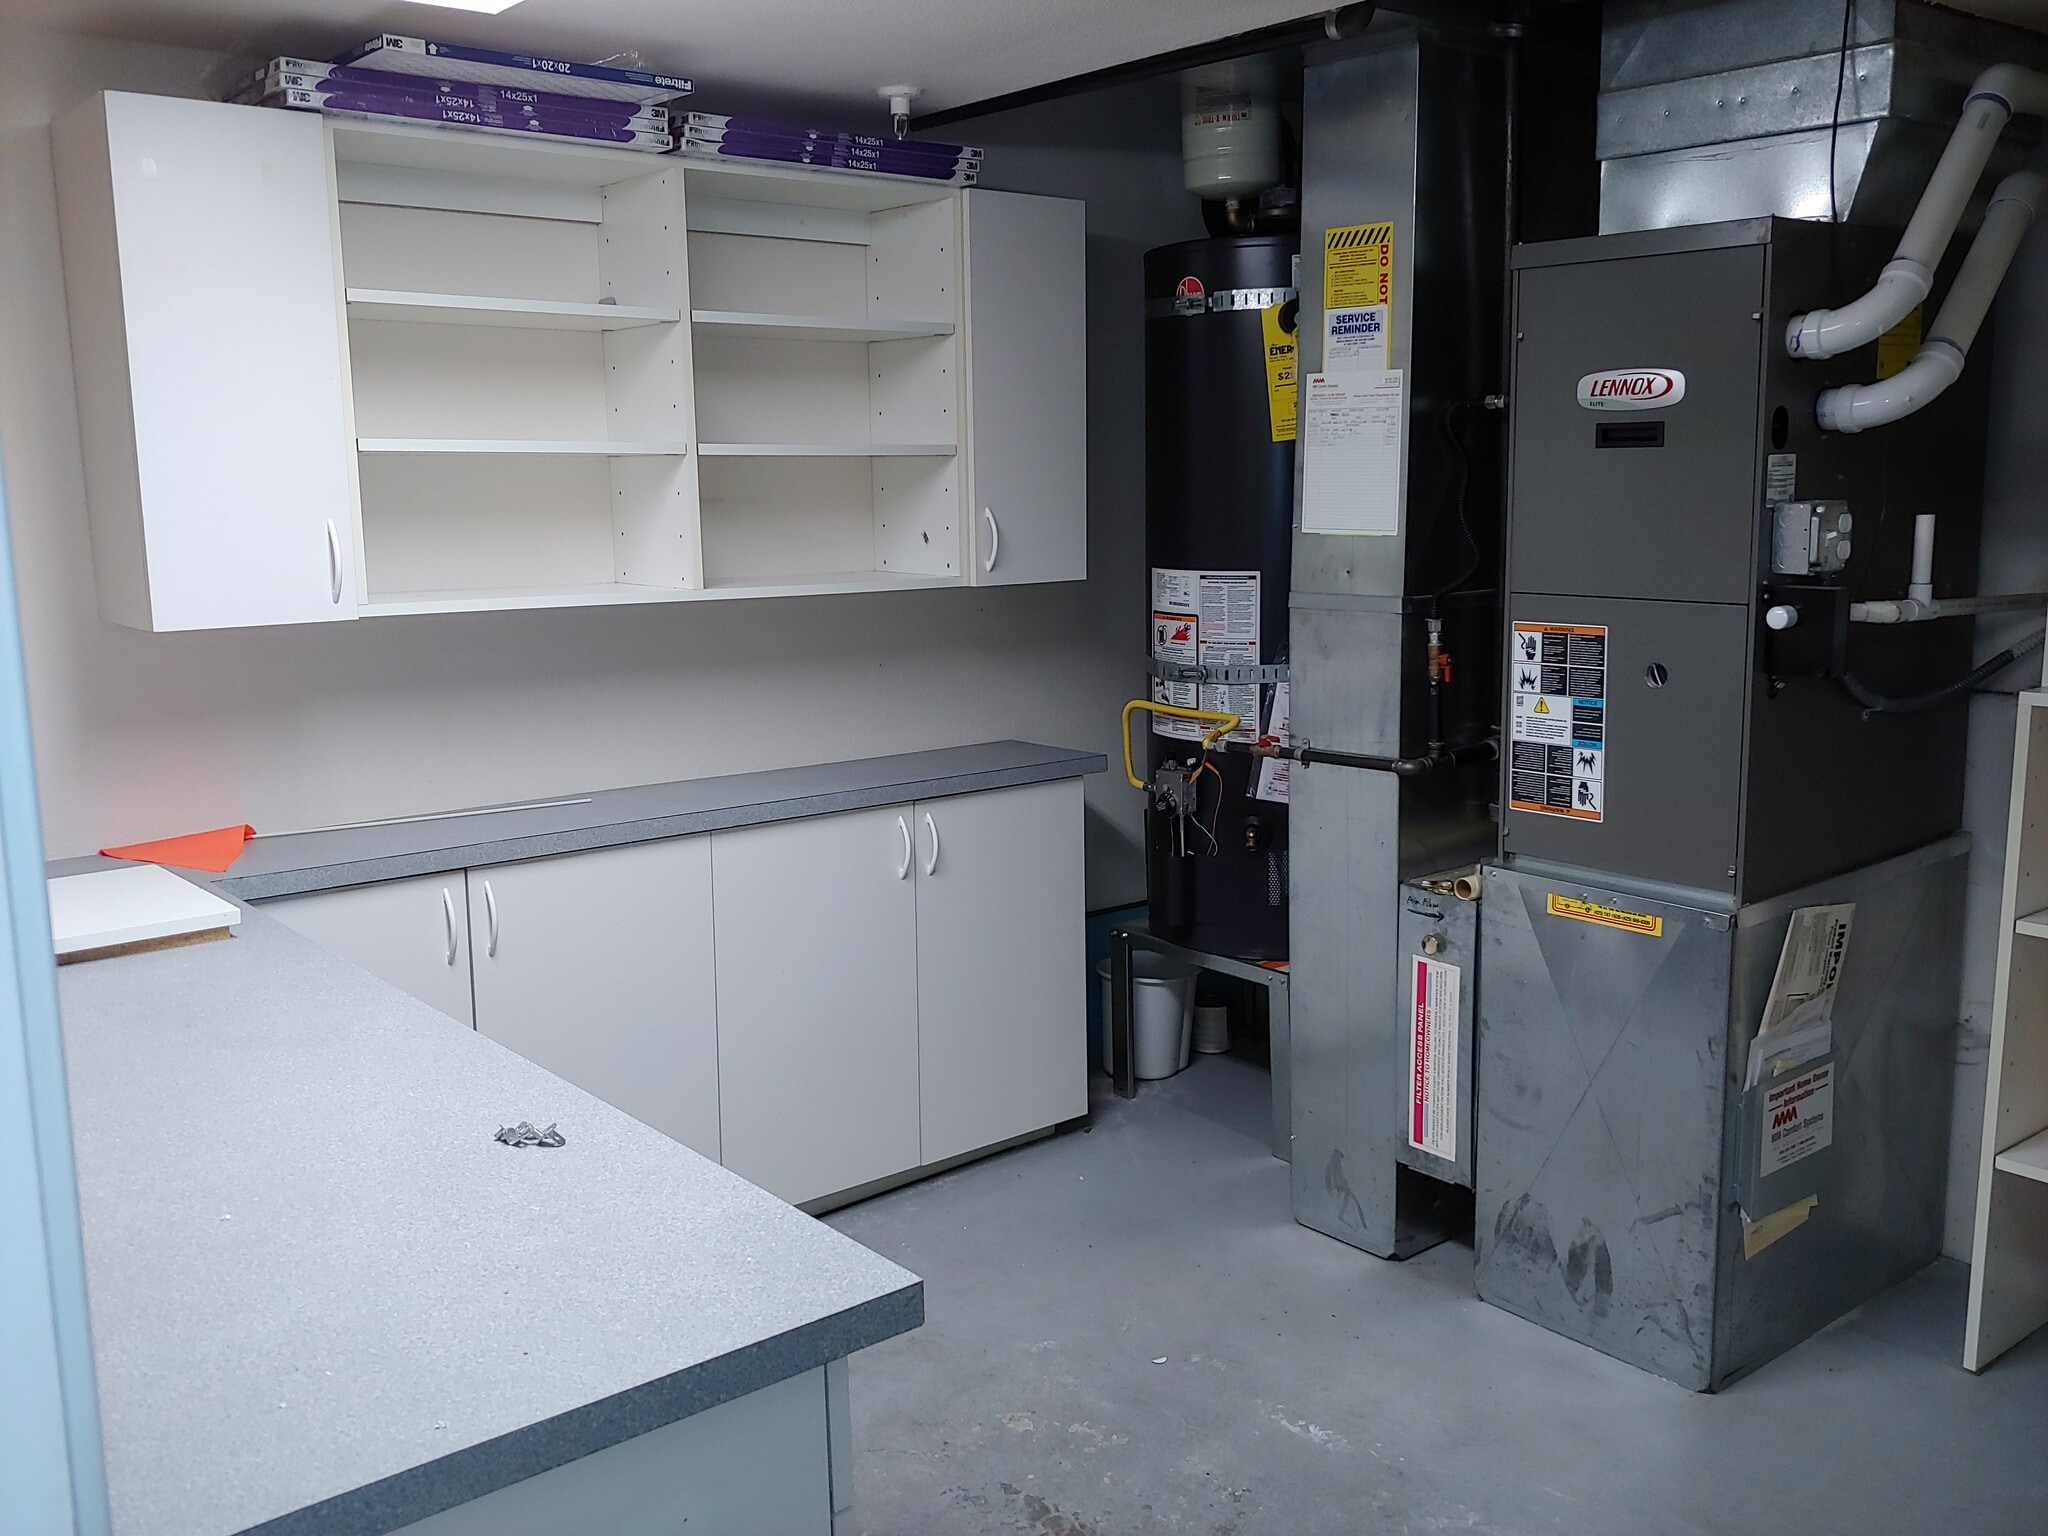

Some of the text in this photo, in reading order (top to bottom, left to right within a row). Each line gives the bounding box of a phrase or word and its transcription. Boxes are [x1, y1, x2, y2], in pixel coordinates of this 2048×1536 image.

[386, 38, 403, 49] 3M
[531, 58, 571, 74] 20x20x1
[655, 75, 692, 90] Filtrete
[435, 94, 474, 108] 14x25x1
[500, 90, 538, 103] 14x25x1
[442, 110, 481, 123] 14x25x1
[651, 108, 666, 119] 3M
[855, 136, 884, 146] 14x25x1
[851, 149, 880, 159] 14x25x1
[970, 149, 983, 158] 3M
[847, 159, 877, 170] 14x25x1
[966, 161, 978, 171] 3M
[963, 173, 975, 182] 3M
[1379, 244, 1389, 305] DO NOT
[1336, 312, 1376, 324] SERVICE
[1331, 322, 1380, 335] REMINDER
[1590, 377, 1656, 397] LENNOX
[1425, 1063, 1430, 1073] TO
